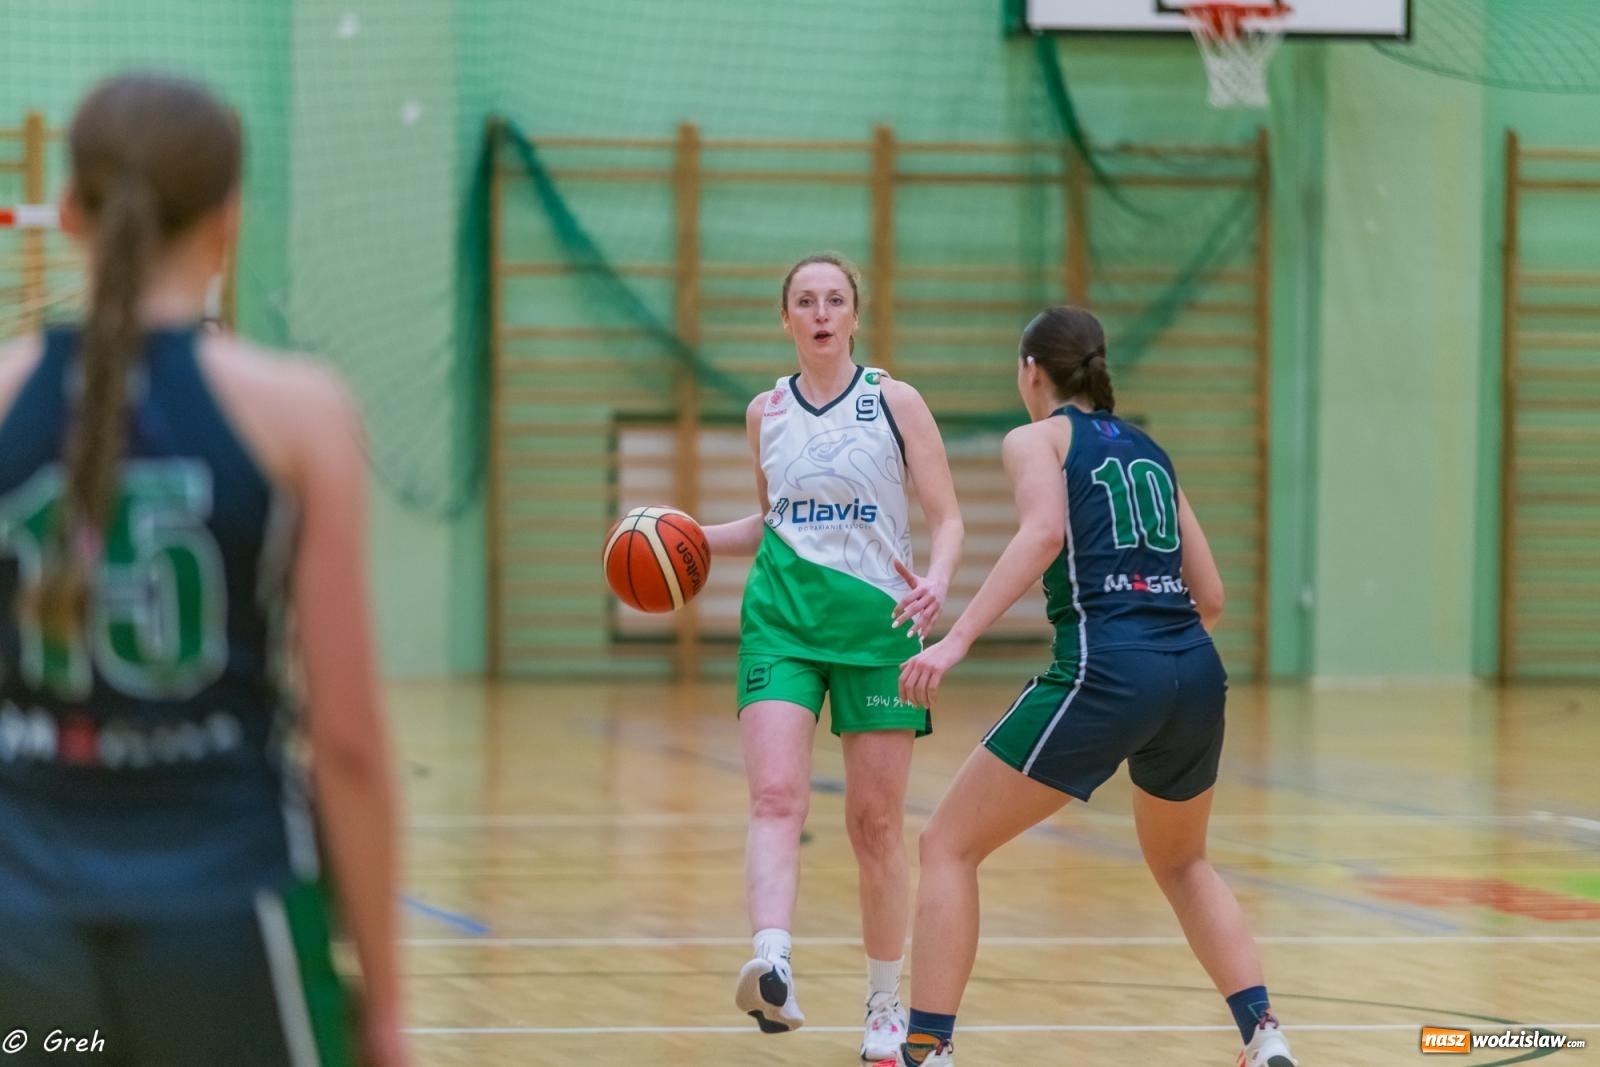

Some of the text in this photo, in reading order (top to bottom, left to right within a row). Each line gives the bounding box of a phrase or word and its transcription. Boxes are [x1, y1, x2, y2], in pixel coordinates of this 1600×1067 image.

[856, 394, 879, 421] 9
[791, 499, 878, 523] Clavis
[1091, 457, 1180, 552] 10
